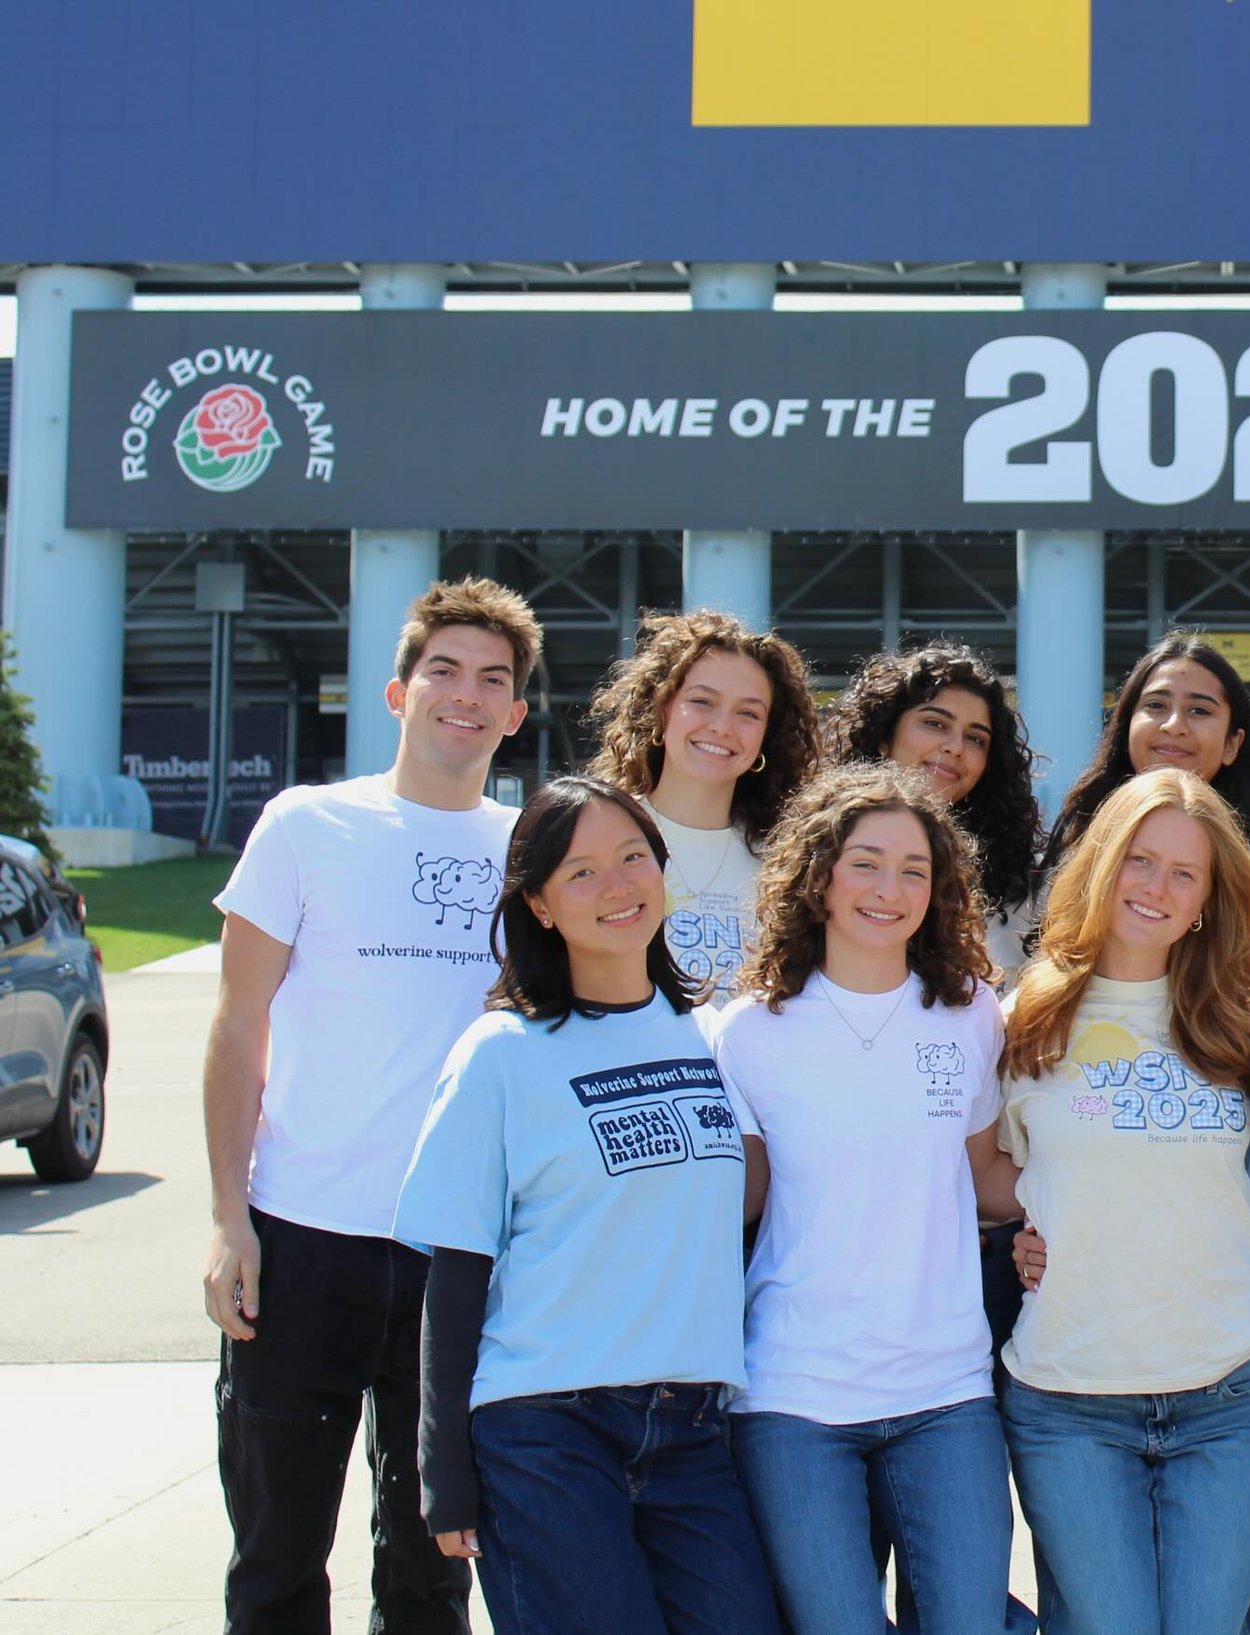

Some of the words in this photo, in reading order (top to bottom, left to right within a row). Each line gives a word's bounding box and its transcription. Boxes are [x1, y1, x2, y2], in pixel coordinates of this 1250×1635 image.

[121, 378, 173, 482] ROSE
[167, 345, 279, 388] BOWL
[284, 374, 336, 482] GAME
[540, 398, 718, 438] HOME
[728, 398, 810, 438] OF
[820, 398, 936, 438] THE
[123, 754, 272, 778] Timberech
[666, 909, 741, 949] SN
[357, 943, 433, 958] wolverine
[436, 948, 493, 965] support
[580, 1076, 638, 1098] Wolverine
[637, 1069, 682, 1087] Support
[926, 1088, 963, 1096] BECAUSE
[597, 1107, 670, 1135] mental
[928, 1110, 963, 1118] HAPPENS
[1112, 1088, 1247, 1132] 2025
[603, 1120, 678, 1151] health
[1147, 1133, 1188, 1143] Because
[1192, 1133, 1208, 1143] life
[609, 1137, 682, 1165] matters
